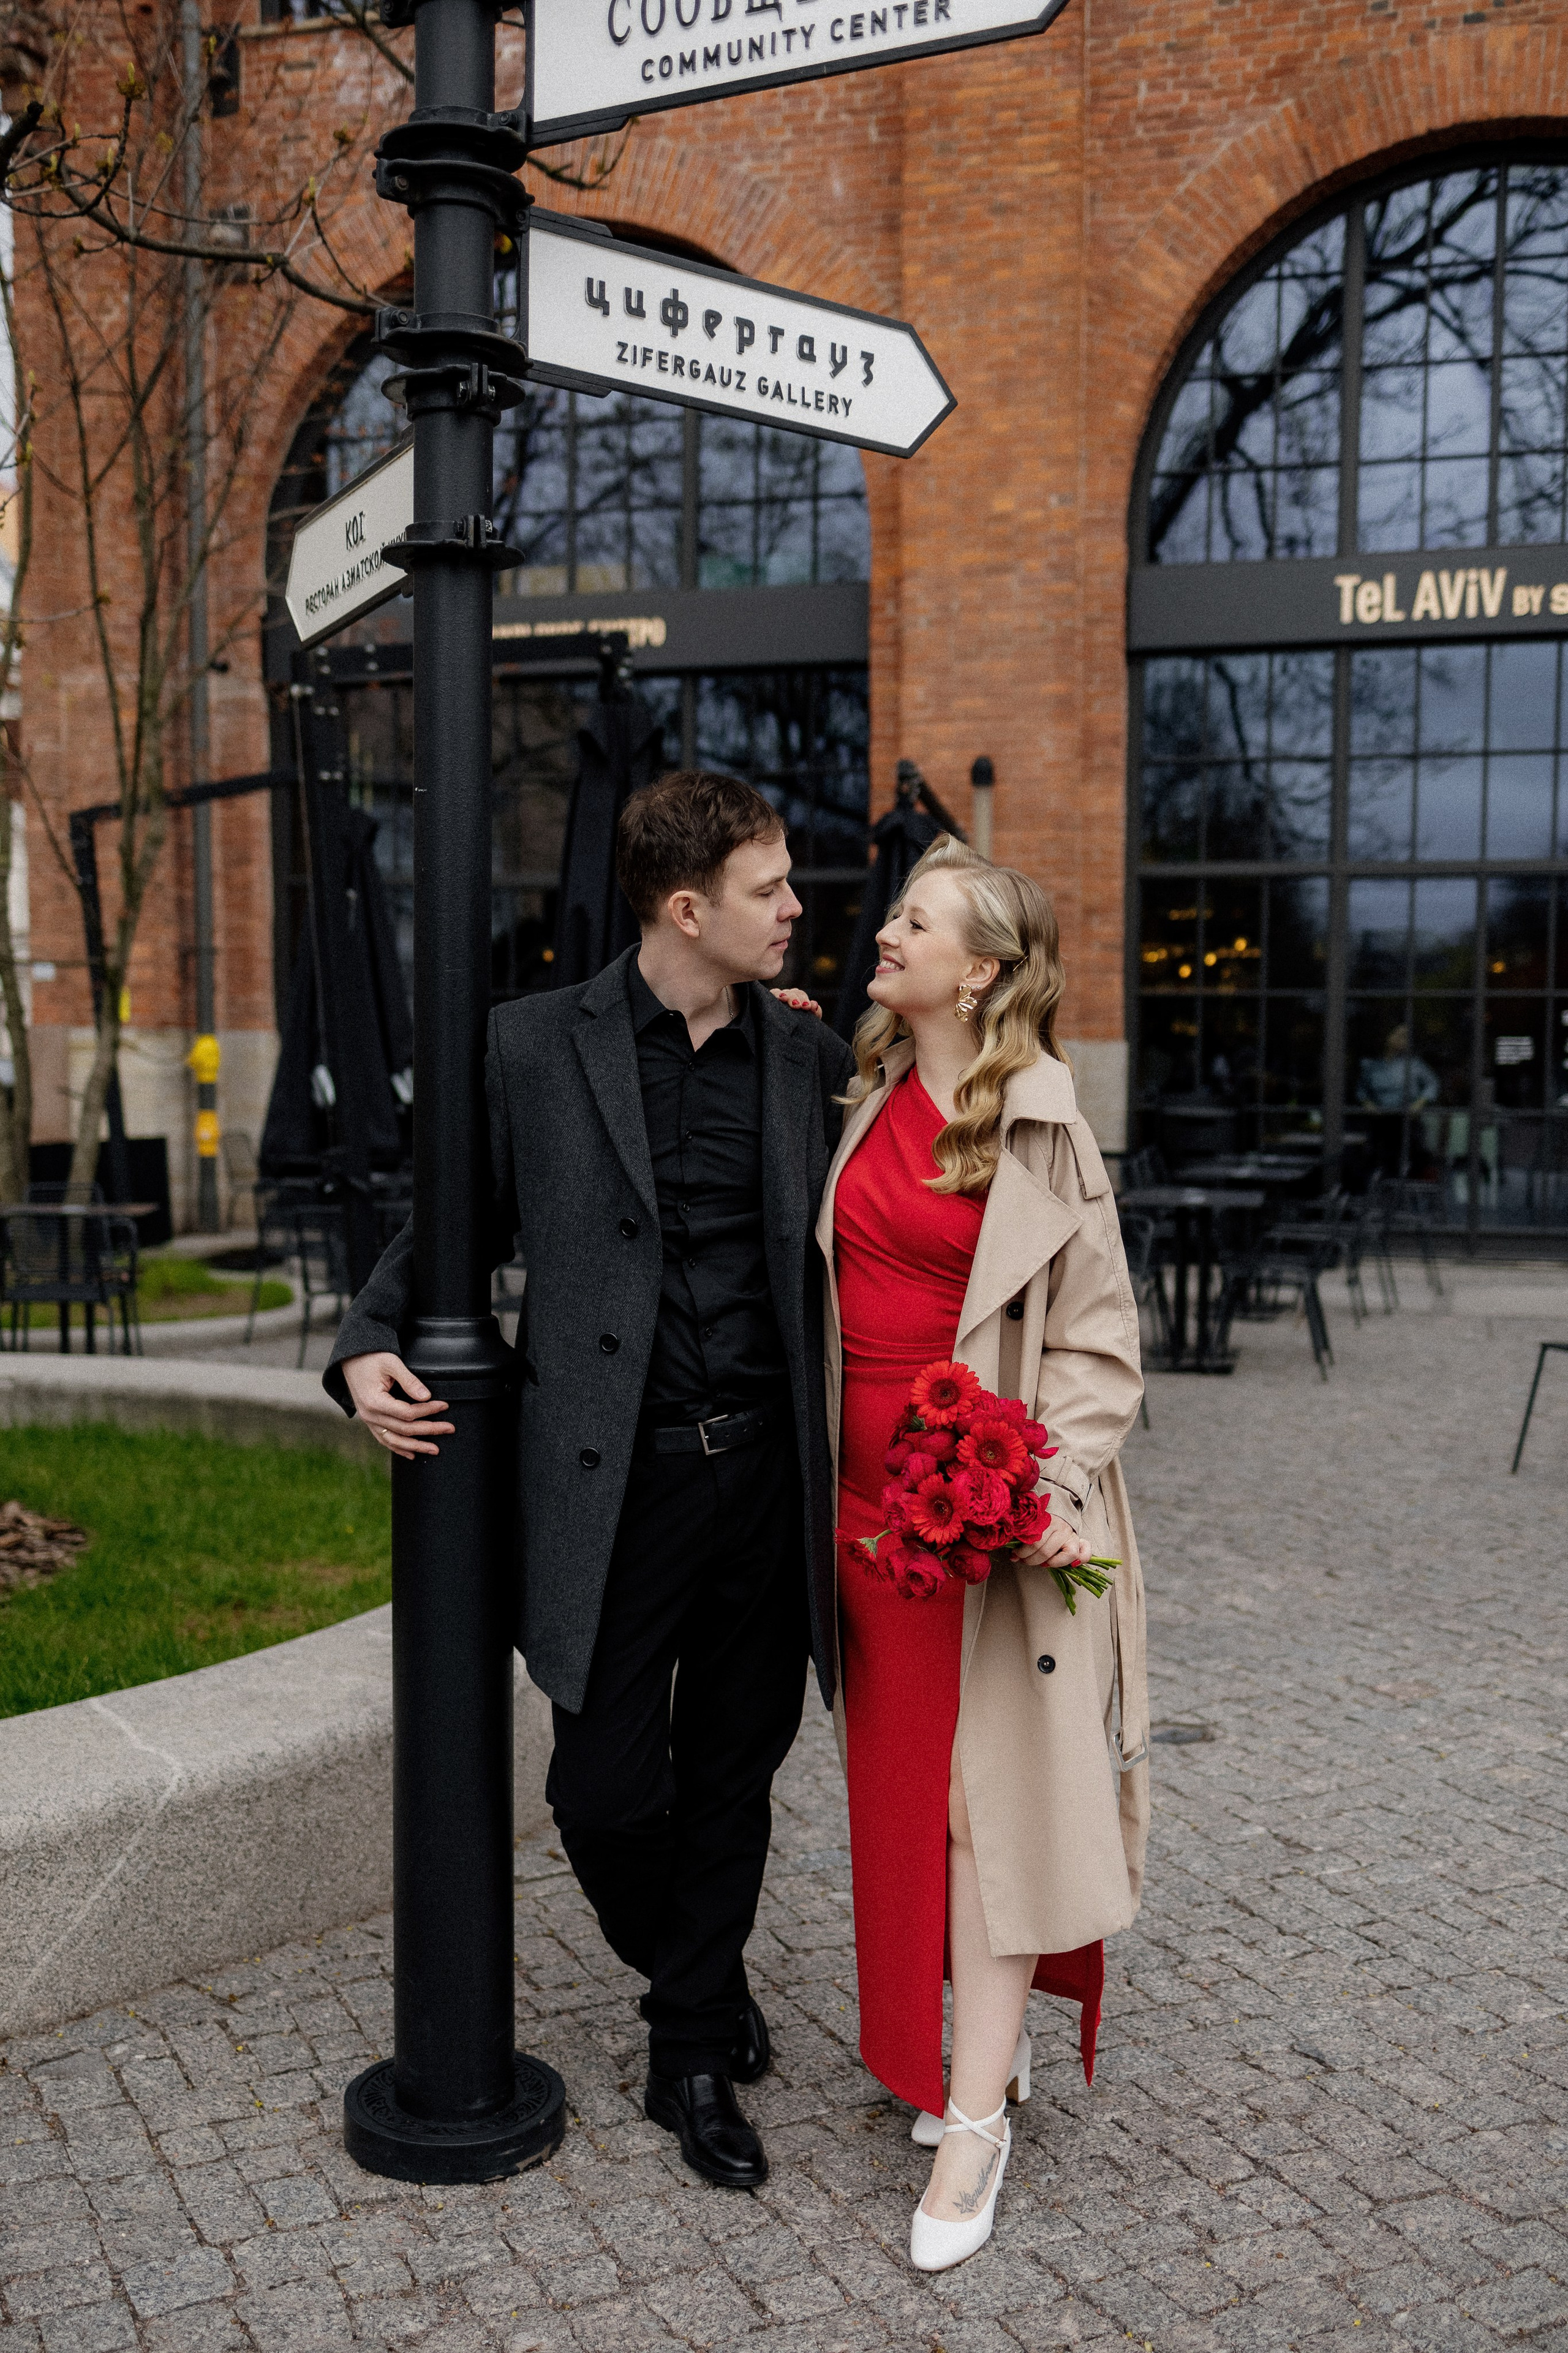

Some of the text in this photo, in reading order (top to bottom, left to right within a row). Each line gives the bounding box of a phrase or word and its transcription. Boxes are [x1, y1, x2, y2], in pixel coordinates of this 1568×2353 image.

[641, 0, 951, 81] COMMUNITY CENTER
[616, 341, 853, 417] ZIFERGAUZ GALLERY
[305, 577, 339, 615] РЕСТОРАН
[1511, 583, 1546, 618] BY
